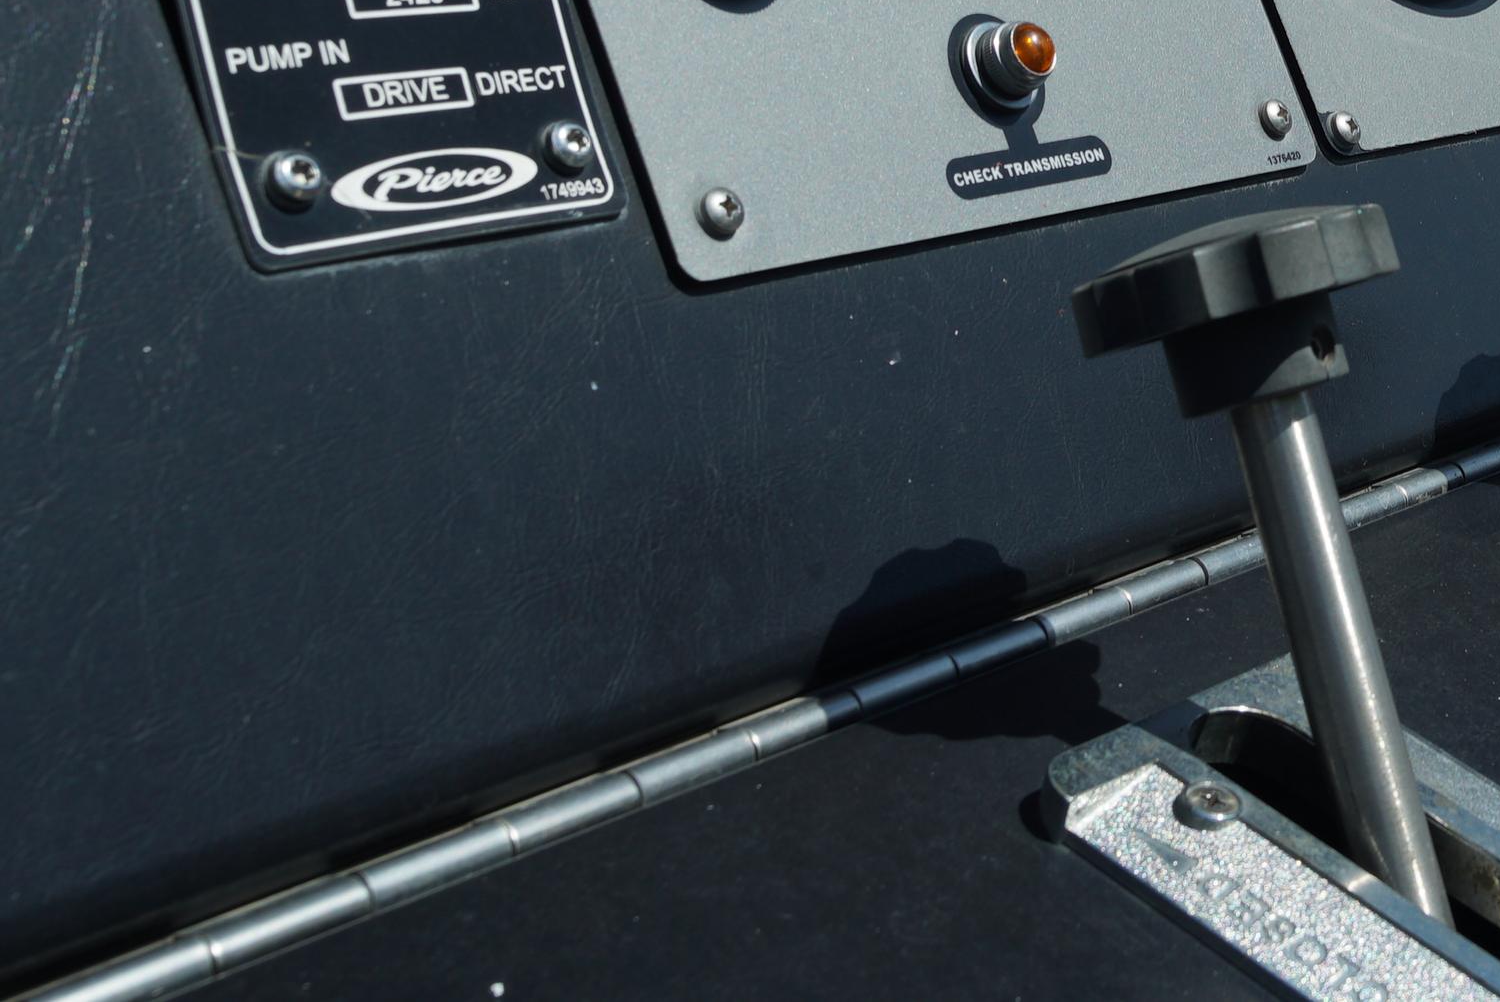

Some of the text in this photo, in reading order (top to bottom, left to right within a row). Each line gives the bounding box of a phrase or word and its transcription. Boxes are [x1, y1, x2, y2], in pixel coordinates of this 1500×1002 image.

[225, 39, 351, 75] PUMP IN
[362, 65, 566, 108] DRIVE DIRECT
[374, 166, 506, 201] Pierce
[953, 147, 1105, 187] CHECK TRANSMISSION
[540, 179, 604, 200] 1749943
